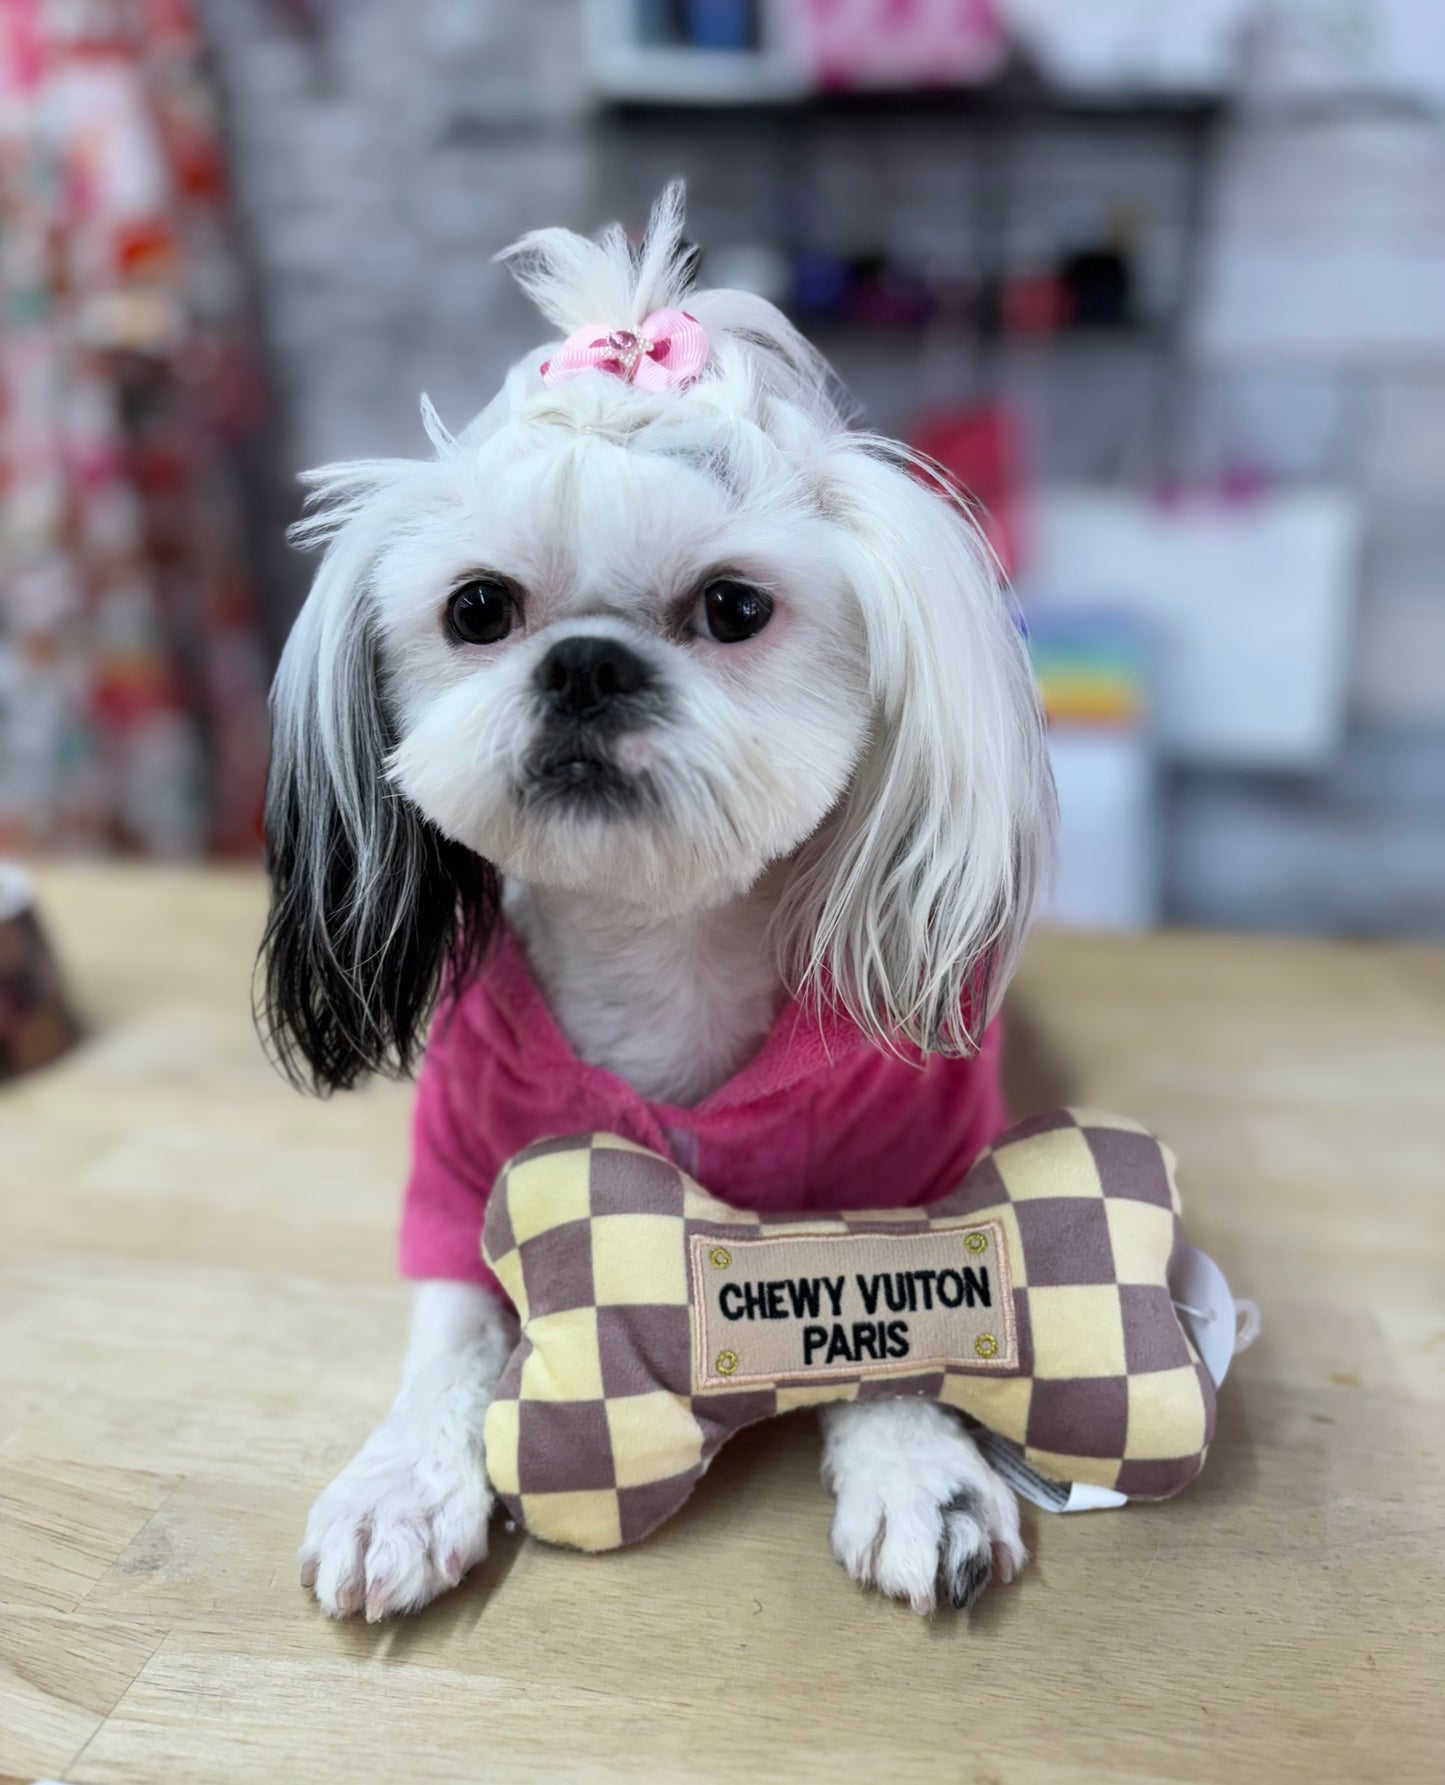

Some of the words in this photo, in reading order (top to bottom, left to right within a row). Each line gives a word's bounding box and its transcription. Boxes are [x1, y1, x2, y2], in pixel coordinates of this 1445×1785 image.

[719, 1275, 845, 1320] CHEWY
[856, 1266, 992, 1315] VUITON
[803, 1321, 909, 1365] PARIS
